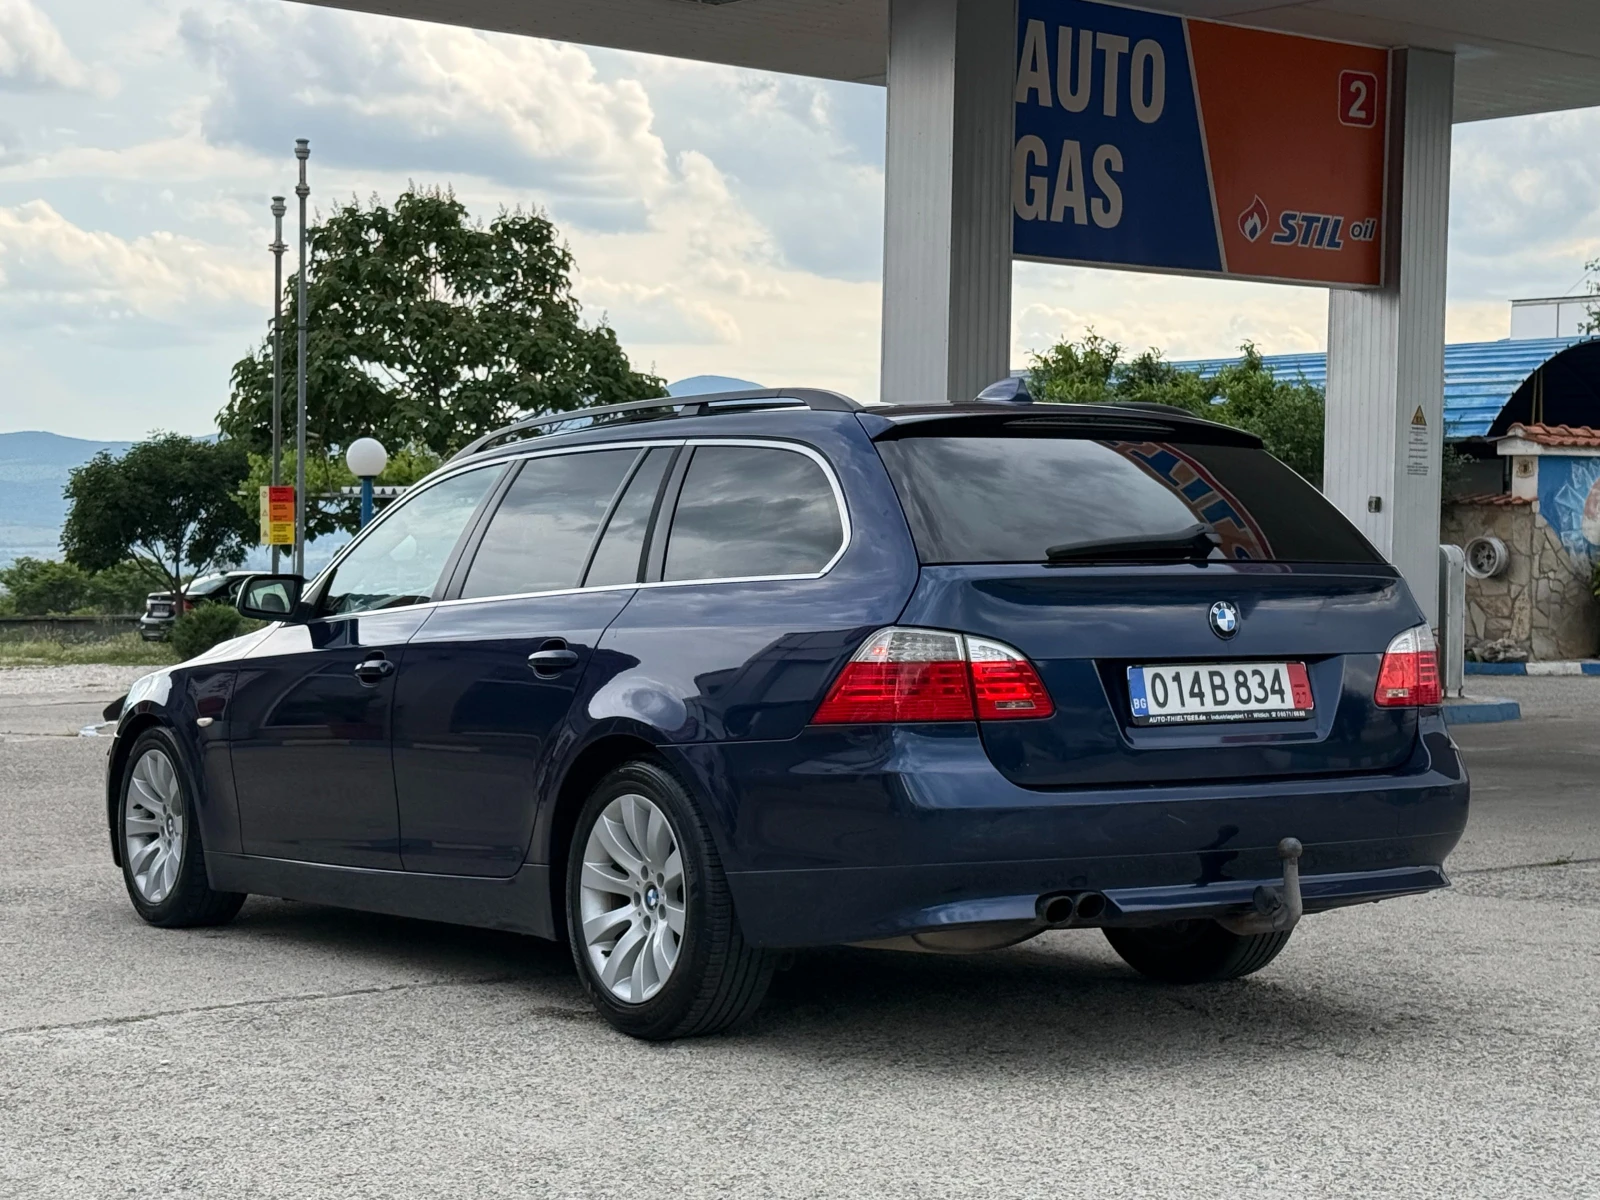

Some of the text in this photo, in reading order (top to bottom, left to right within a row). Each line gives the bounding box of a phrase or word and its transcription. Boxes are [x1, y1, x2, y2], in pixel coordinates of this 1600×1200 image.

[1015, 19, 1165, 123] AUTO
[1348, 81, 1367, 118] 2
[1013, 134, 1123, 229] GAS
[1271, 210, 1377, 250] STIL oil
[1133, 698, 1147, 709] BG
